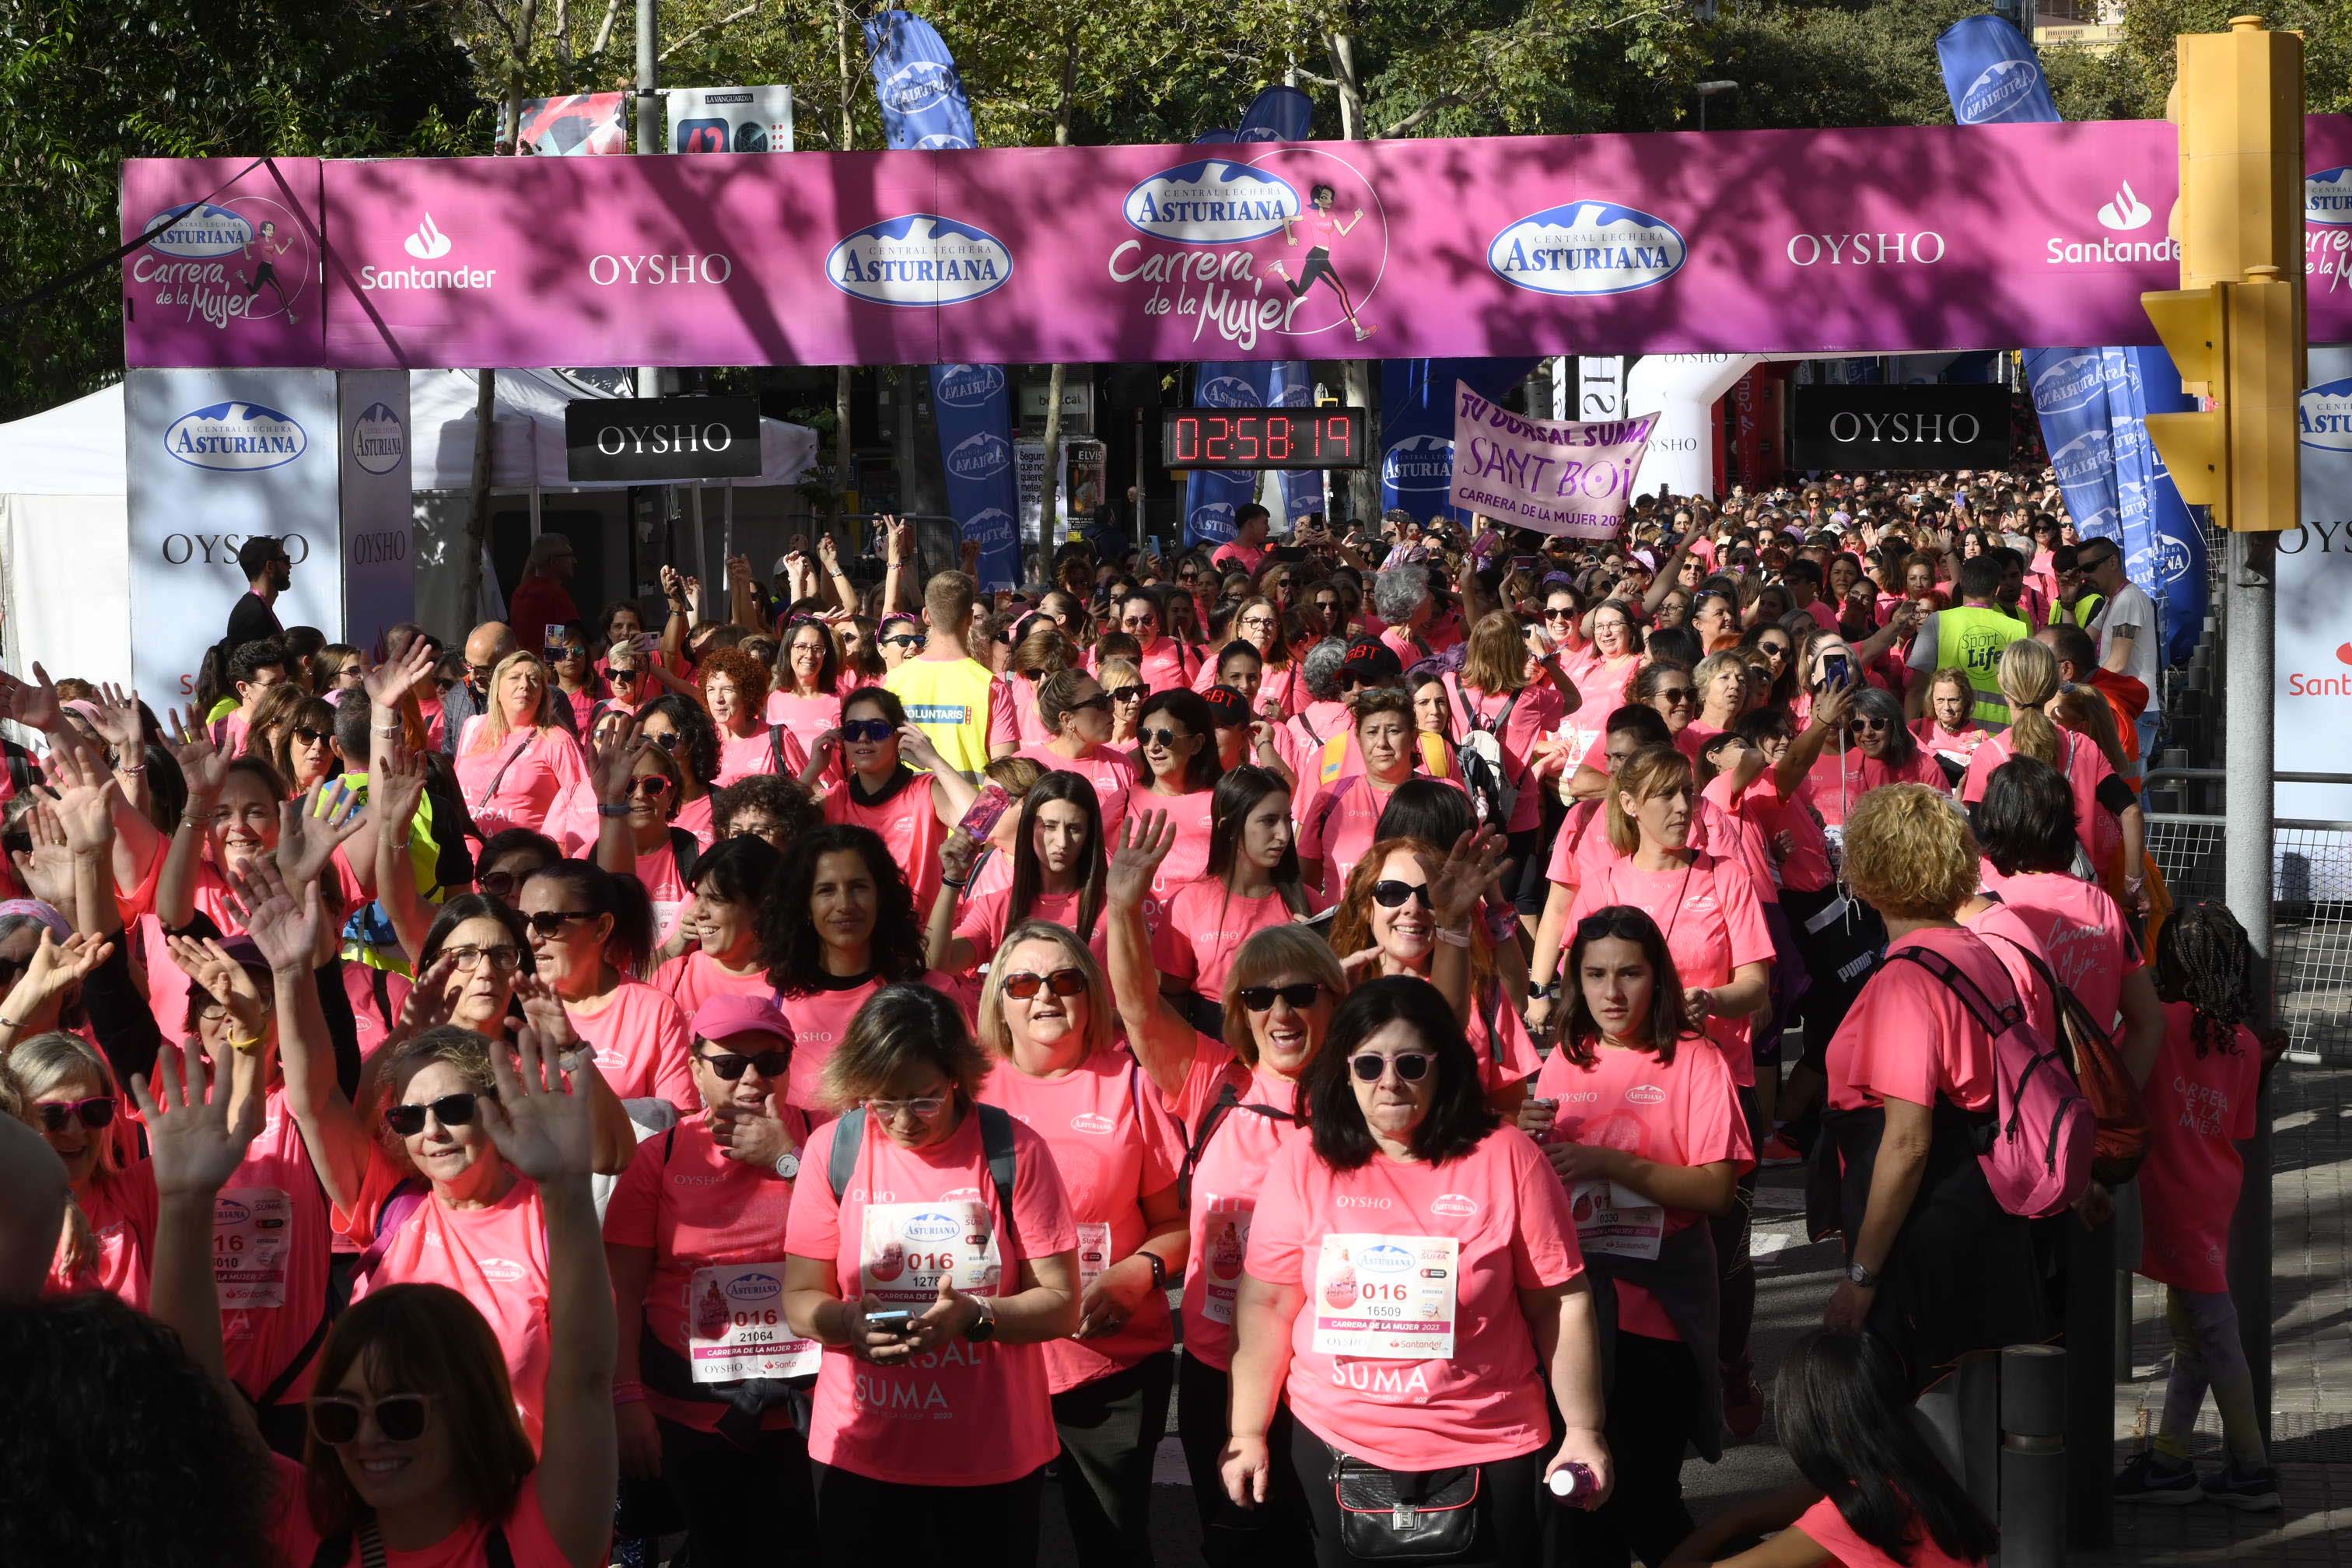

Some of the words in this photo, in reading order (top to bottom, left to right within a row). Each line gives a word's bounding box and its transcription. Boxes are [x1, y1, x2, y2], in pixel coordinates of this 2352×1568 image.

[1164, 188, 1220, 198] CENTRAL
[1226, 187, 1282, 197] LECHERA
[1137, 191, 1286, 223] ASTURIANA
[153, 221, 244, 245] ASTURIANA
[1534, 233, 1598, 244] CENTRAL
[1602, 231, 1664, 243] LECHERA
[869, 245, 928, 255] CENTRAL
[933, 244, 992, 254] LECHERA
[1503, 236, 1671, 272] ASTURIANA
[1787, 232, 1945, 266] OYSHO
[2047, 237, 2181, 264] Santande
[133, 254, 224, 283] Carrera
[589, 254, 732, 285] OYSHO
[840, 247, 999, 282] ASTURIANA
[1108, 240, 1254, 283] Carrera
[362, 265, 496, 291] Santander
[156, 286, 172, 305] de
[177, 285, 188, 305] la
[187, 281, 259, 329] Mujer
[1145, 287, 1171, 315] de
[1178, 283, 1197, 315] la
[1192, 278, 1308, 351] Mujer
[1461, 392, 1489, 422] TU
[1490, 406, 1577, 446] DORSAL
[1584, 418, 1650, 447] SUMA
[1829, 411, 1980, 444] OYSHO
[197, 425, 243, 434] CENTRAL
[247, 425, 292, 433] LECHERA
[597, 422, 731, 456] OYSHO
[1176, 416, 1350, 460] 02:58:19
[176, 427, 297, 453] ASTURIANA
[356, 429, 401, 457] ASTURIANA
[1650, 437, 1697, 452] YSHO
[1078, 450, 1103, 460] ELVIS
[1462, 436, 1556, 493] SANT
[1384, 460, 1452, 479] ASTURIA
[1459, 487, 1517, 512] CARRERA
[1521, 502, 1536, 517] DE
[1538, 507, 1551, 521] LA
[1554, 511, 1598, 526] MUJER
[162, 534, 310, 565] OYSO
[354, 530, 405, 565] OYSHO
[1962, 632, 1999, 649] Sport
[1967, 646, 2004, 671] Life
[1201, 930, 1239, 943] OYSHO
[794, 1031, 832, 1044] YSHO
[1556, 1091, 1597, 1104] OYSHO
[1628, 1090, 1662, 1102] ASTURIANA
[1336, 1194, 1391, 1210] OYSHO
[907, 1225, 956, 1235] ASTURIANA
[213, 1234, 244, 1252] 16
[907, 1252, 955, 1271] 016
[1362, 1254, 1412, 1268] ASTURIANA
[730, 1284, 779, 1296] ASTURIANA
[1362, 1283, 1408, 1301] 016
[734, 1309, 778, 1328] 016
[1214, 1304, 1232, 1316] OYS
[1367, 1306, 1402, 1318] 16509
[1331, 1320, 1367, 1329] CARRERA
[1369, 1321, 1381, 1330] DE
[1393, 1323, 1419, 1332] MUJER
[740, 1331, 774, 1342] 21064
[1401, 1340, 1444, 1350] Santander
[707, 1348, 742, 1357] CARRERA
[766, 1345, 792, 1353] MUJER
[705, 1363, 743, 1374] OYSHO
[1331, 1360, 1430, 1394] SUMA
[855, 1373, 949, 1410] SUMA
